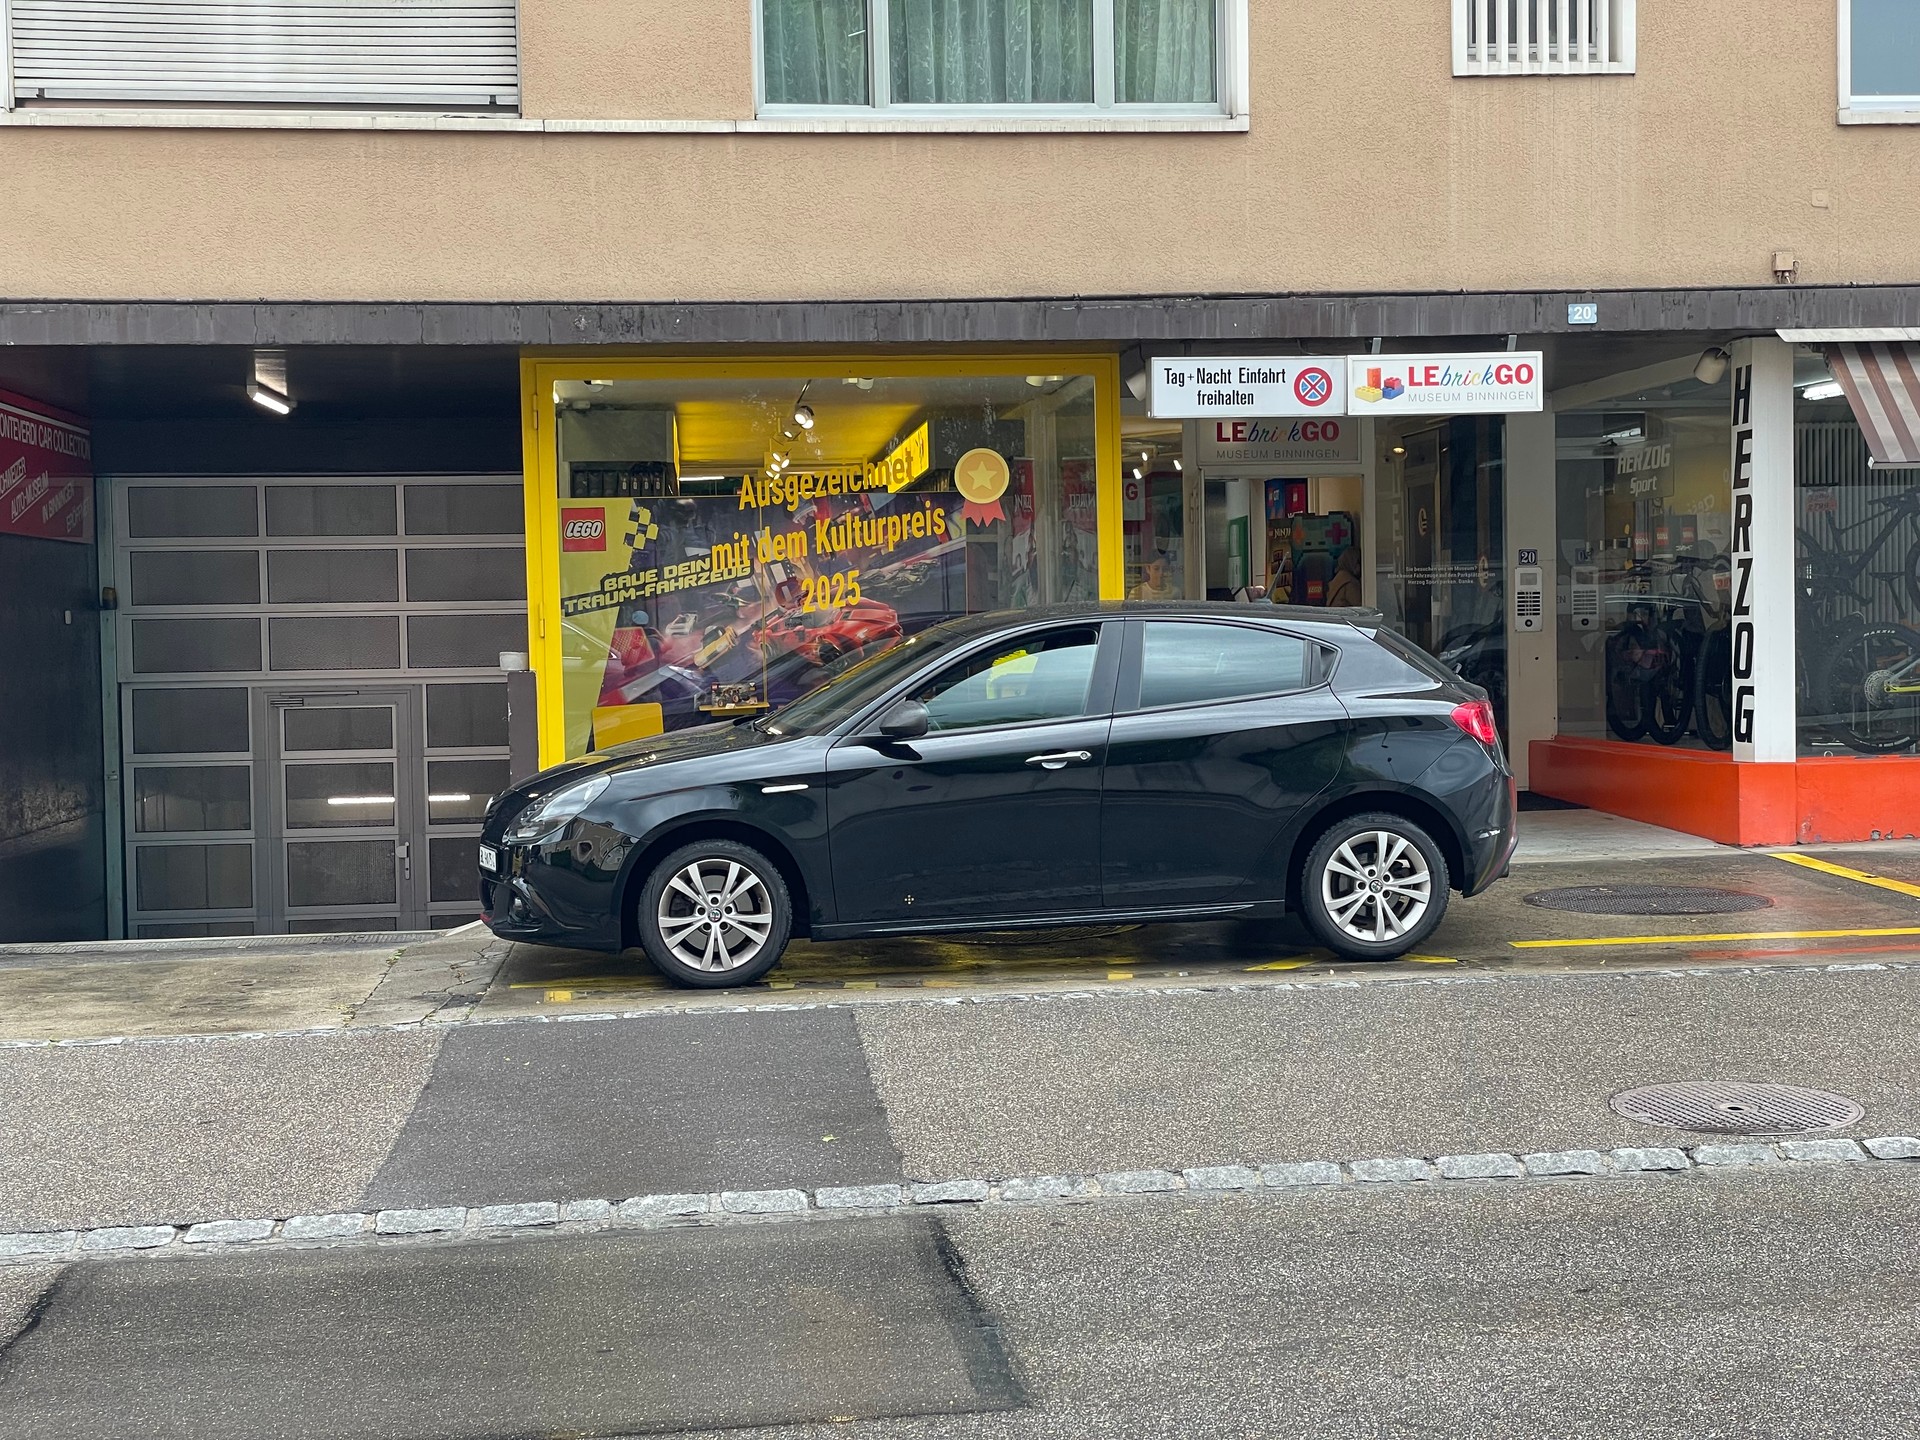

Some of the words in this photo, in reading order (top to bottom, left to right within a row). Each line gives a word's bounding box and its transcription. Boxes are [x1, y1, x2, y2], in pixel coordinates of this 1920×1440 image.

[1574, 306, 1591, 320] 20
[1239, 367, 1286, 384] Einfahrt
[1408, 363, 1534, 387] LEbrickGO
[1197, 390, 1254, 406] freihalten
[1408, 393, 1461, 403] MUSEUM
[1467, 391, 1534, 401] BINNINGEN
[38, 425, 53, 450] CAR
[53, 429, 91, 460] COLLECTION
[1216, 421, 1340, 443] LEbrickGO
[1217, 449, 1269, 459] MUSEUM
[1274, 449, 1340, 459] BINNINGEN
[739, 450, 914, 511] Ausgezeichnet
[1630, 475, 1657, 497] Sport
[11, 470, 49, 519] AUTO-MUSEUM
[566, 521, 602, 538] LEGO
[712, 532, 750, 571] mit
[758, 526, 808, 564] dem
[816, 500, 946, 554] Kulturpreis
[1521, 551, 1535, 563] 20
[1733, 364, 1754, 744] HERZOG
[604, 569, 658, 592] BAUE
[663, 557, 711, 578] DEIN
[564, 565, 751, 613] TRAUM-FAHRZEUG
[801, 569, 861, 614] 2025
[1308, 585, 1322, 593] LEGO
